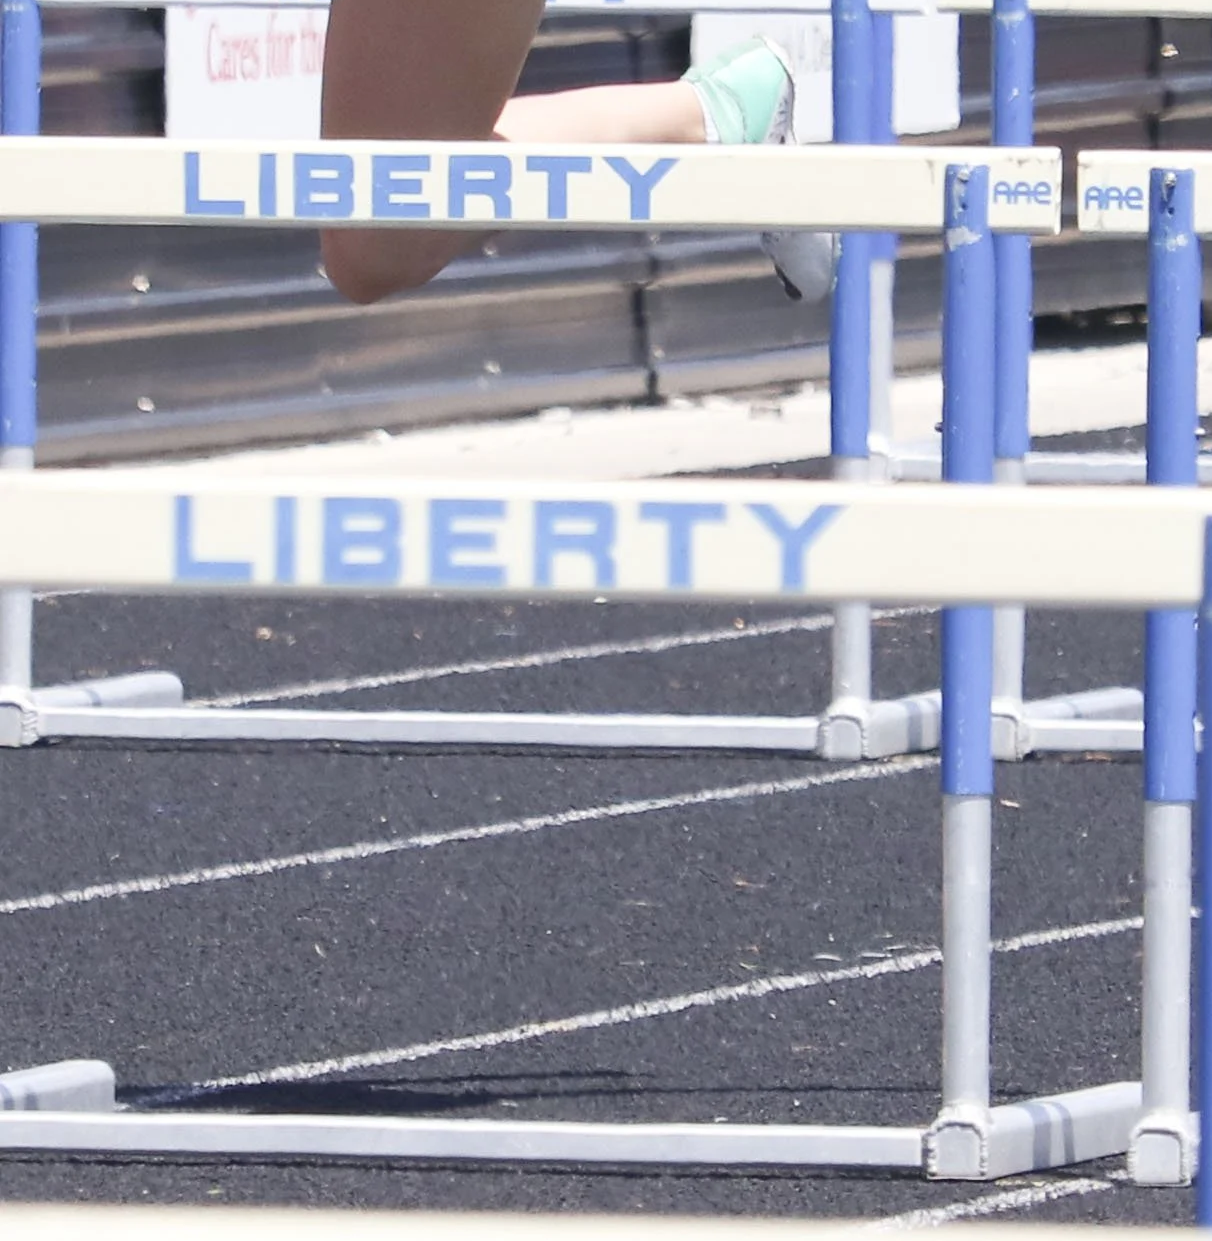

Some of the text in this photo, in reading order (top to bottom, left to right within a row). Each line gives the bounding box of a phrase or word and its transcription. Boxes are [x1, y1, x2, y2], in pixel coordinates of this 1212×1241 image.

[207, 19, 260, 83] Cares
[183, 151, 680, 220] LIBERTY
[173, 493, 845, 591] LIBERTY
